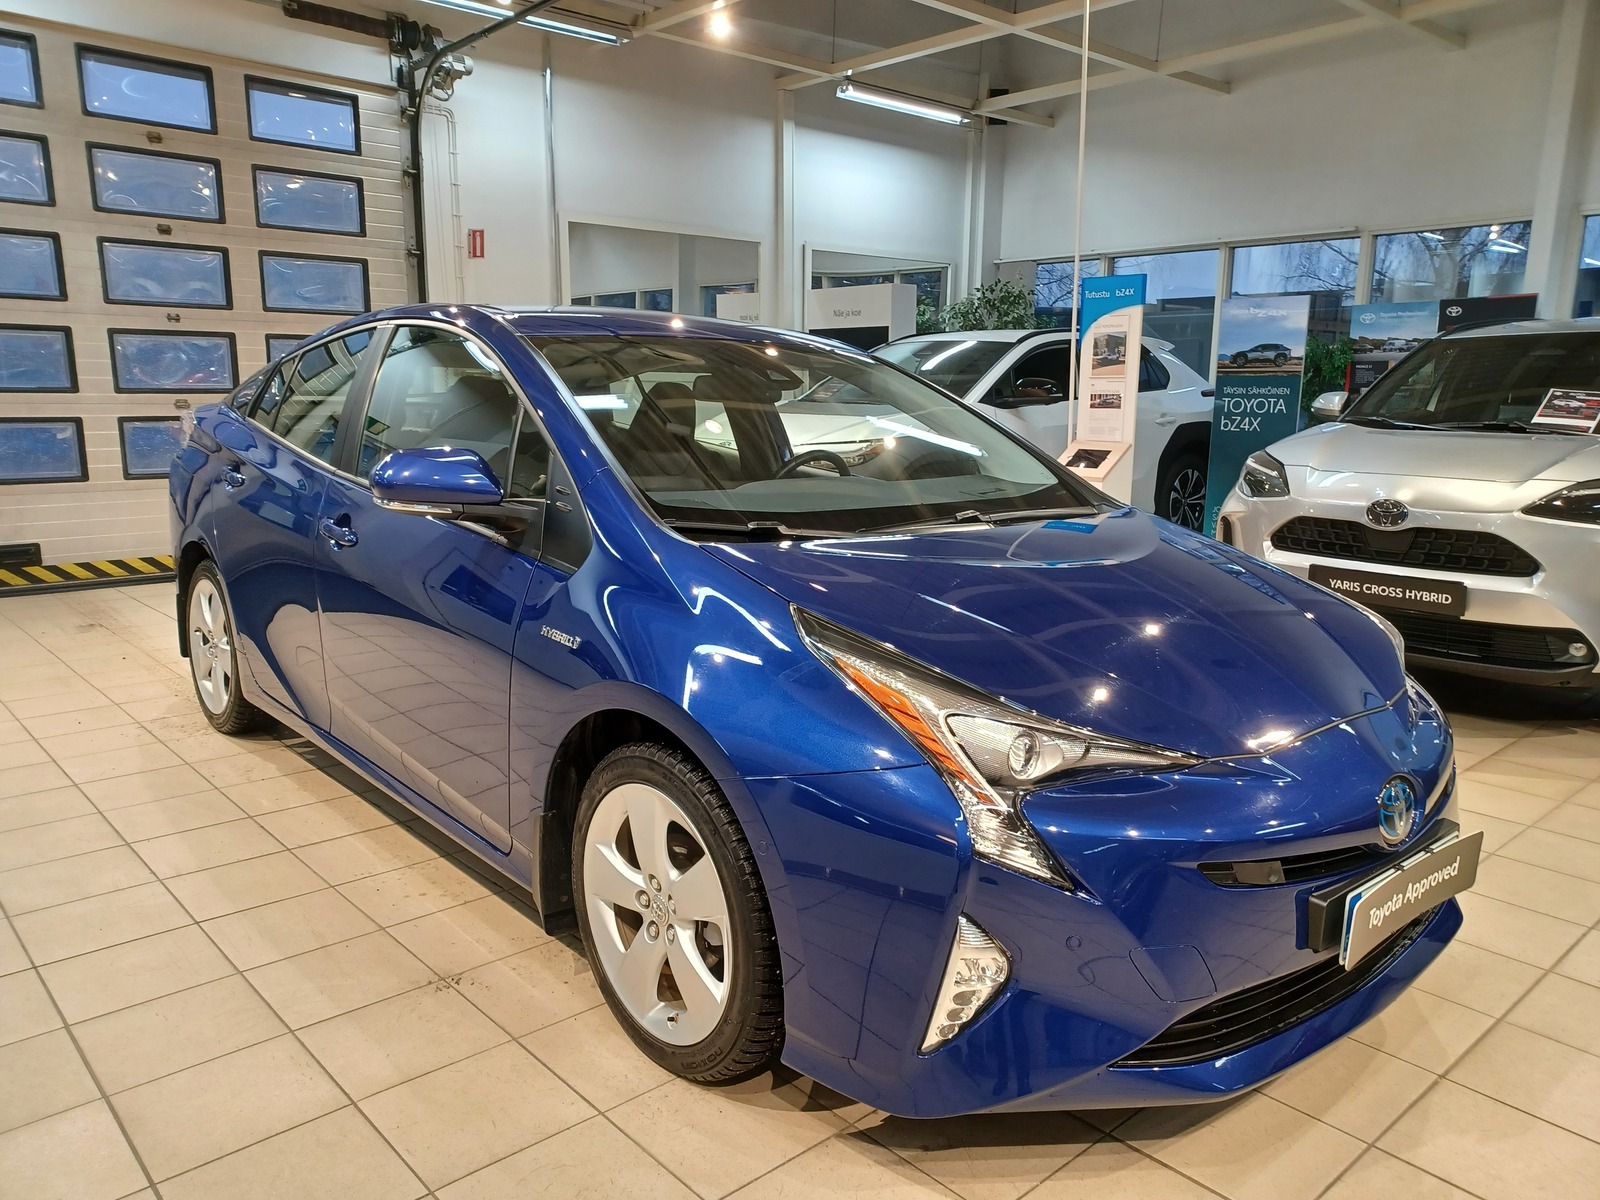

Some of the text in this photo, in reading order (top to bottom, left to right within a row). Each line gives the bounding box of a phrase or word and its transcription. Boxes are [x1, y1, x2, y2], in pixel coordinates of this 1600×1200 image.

[1084, 288, 1135, 299] Tutustu bZ4X
[833, 308, 862, 319] Näe ja koe
[1223, 386, 1290, 395] TÄYSIN SÄHKÖINEN
[1222, 398, 1287, 414] TOYOTA
[1220, 416, 1261, 432] bZ4X
[1329, 578, 1452, 604] YARIS CROSS HYBRID
[1369, 856, 1460, 929] Toyota Approved
